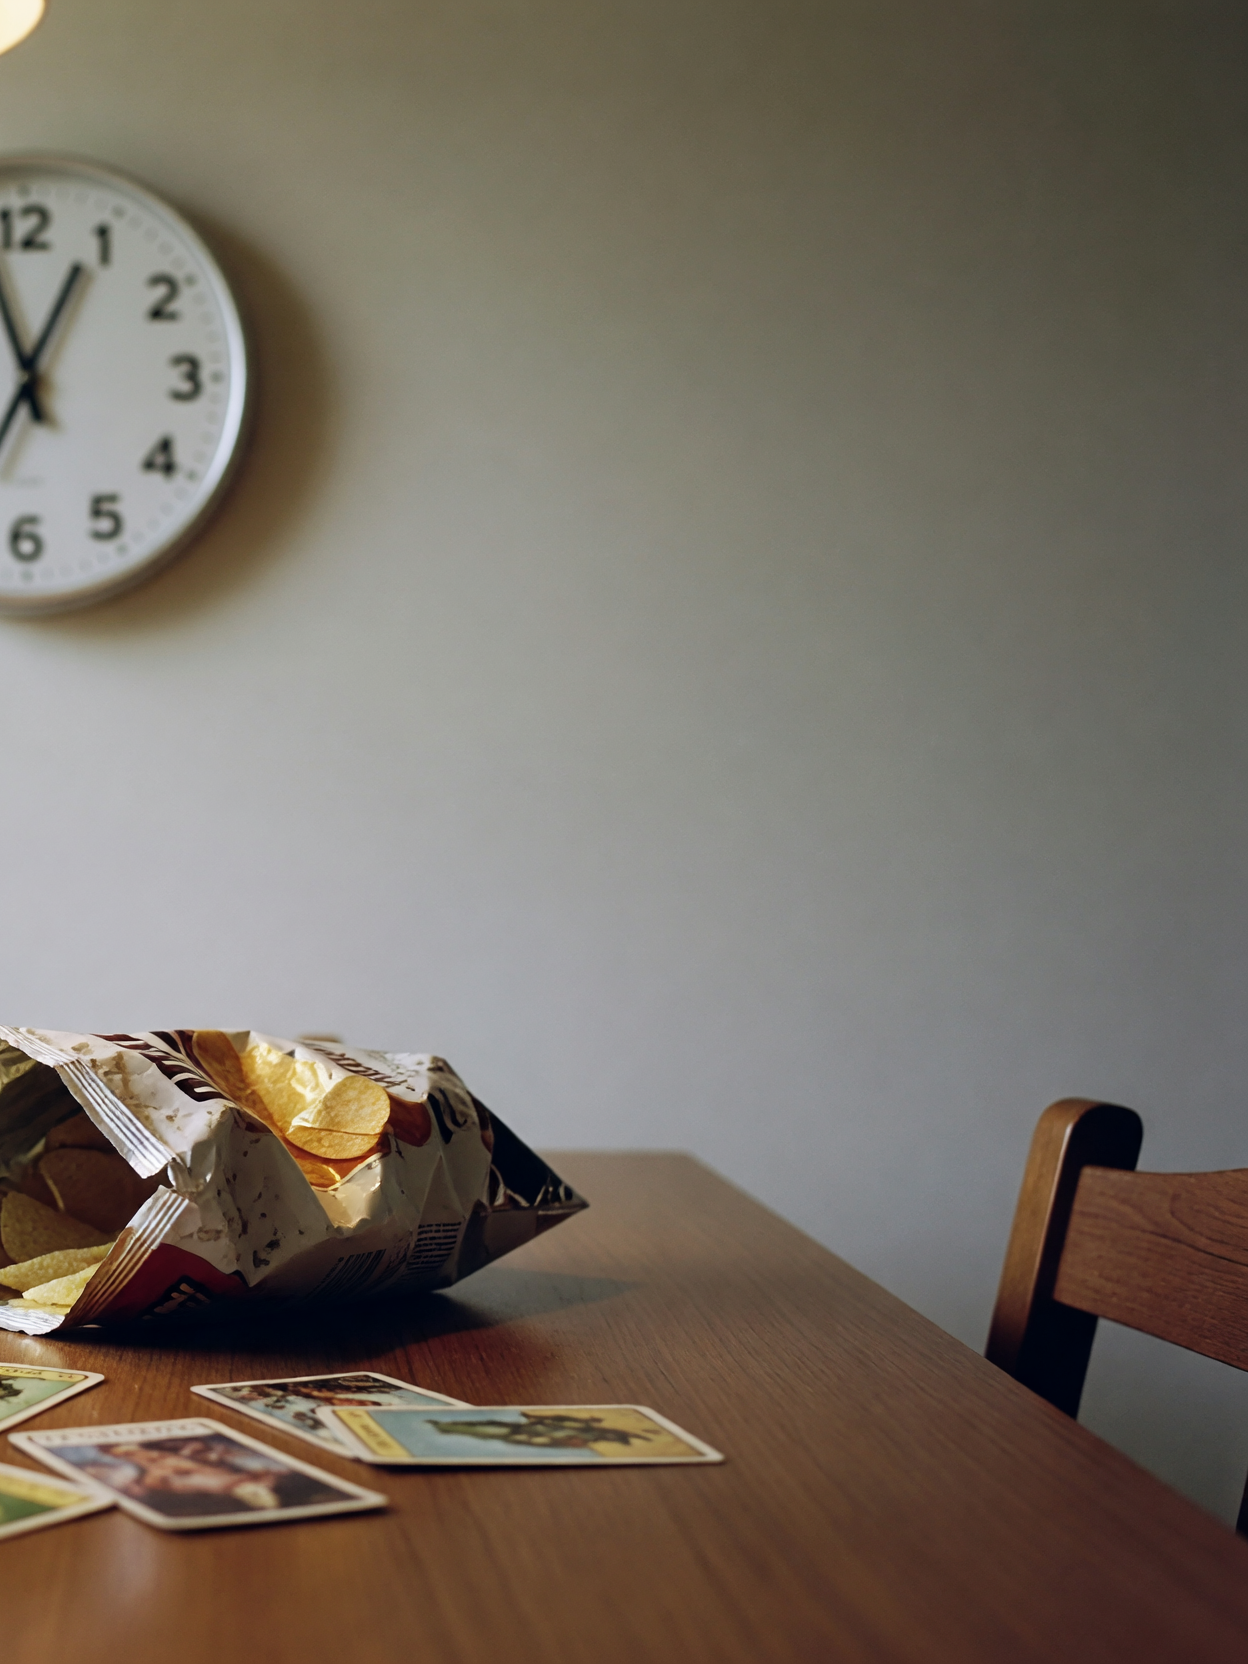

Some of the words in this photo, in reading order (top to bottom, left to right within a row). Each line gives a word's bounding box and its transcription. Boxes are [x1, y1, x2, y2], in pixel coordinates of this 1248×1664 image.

[0, 204, 51, 252] 12
[93, 222, 111, 267] 1
[147, 273, 179, 322] 2
[170, 354, 203, 402] 3
[141, 434, 177, 479] 4
[8, 515, 44, 563] 6
[89, 494, 123, 542] 5
